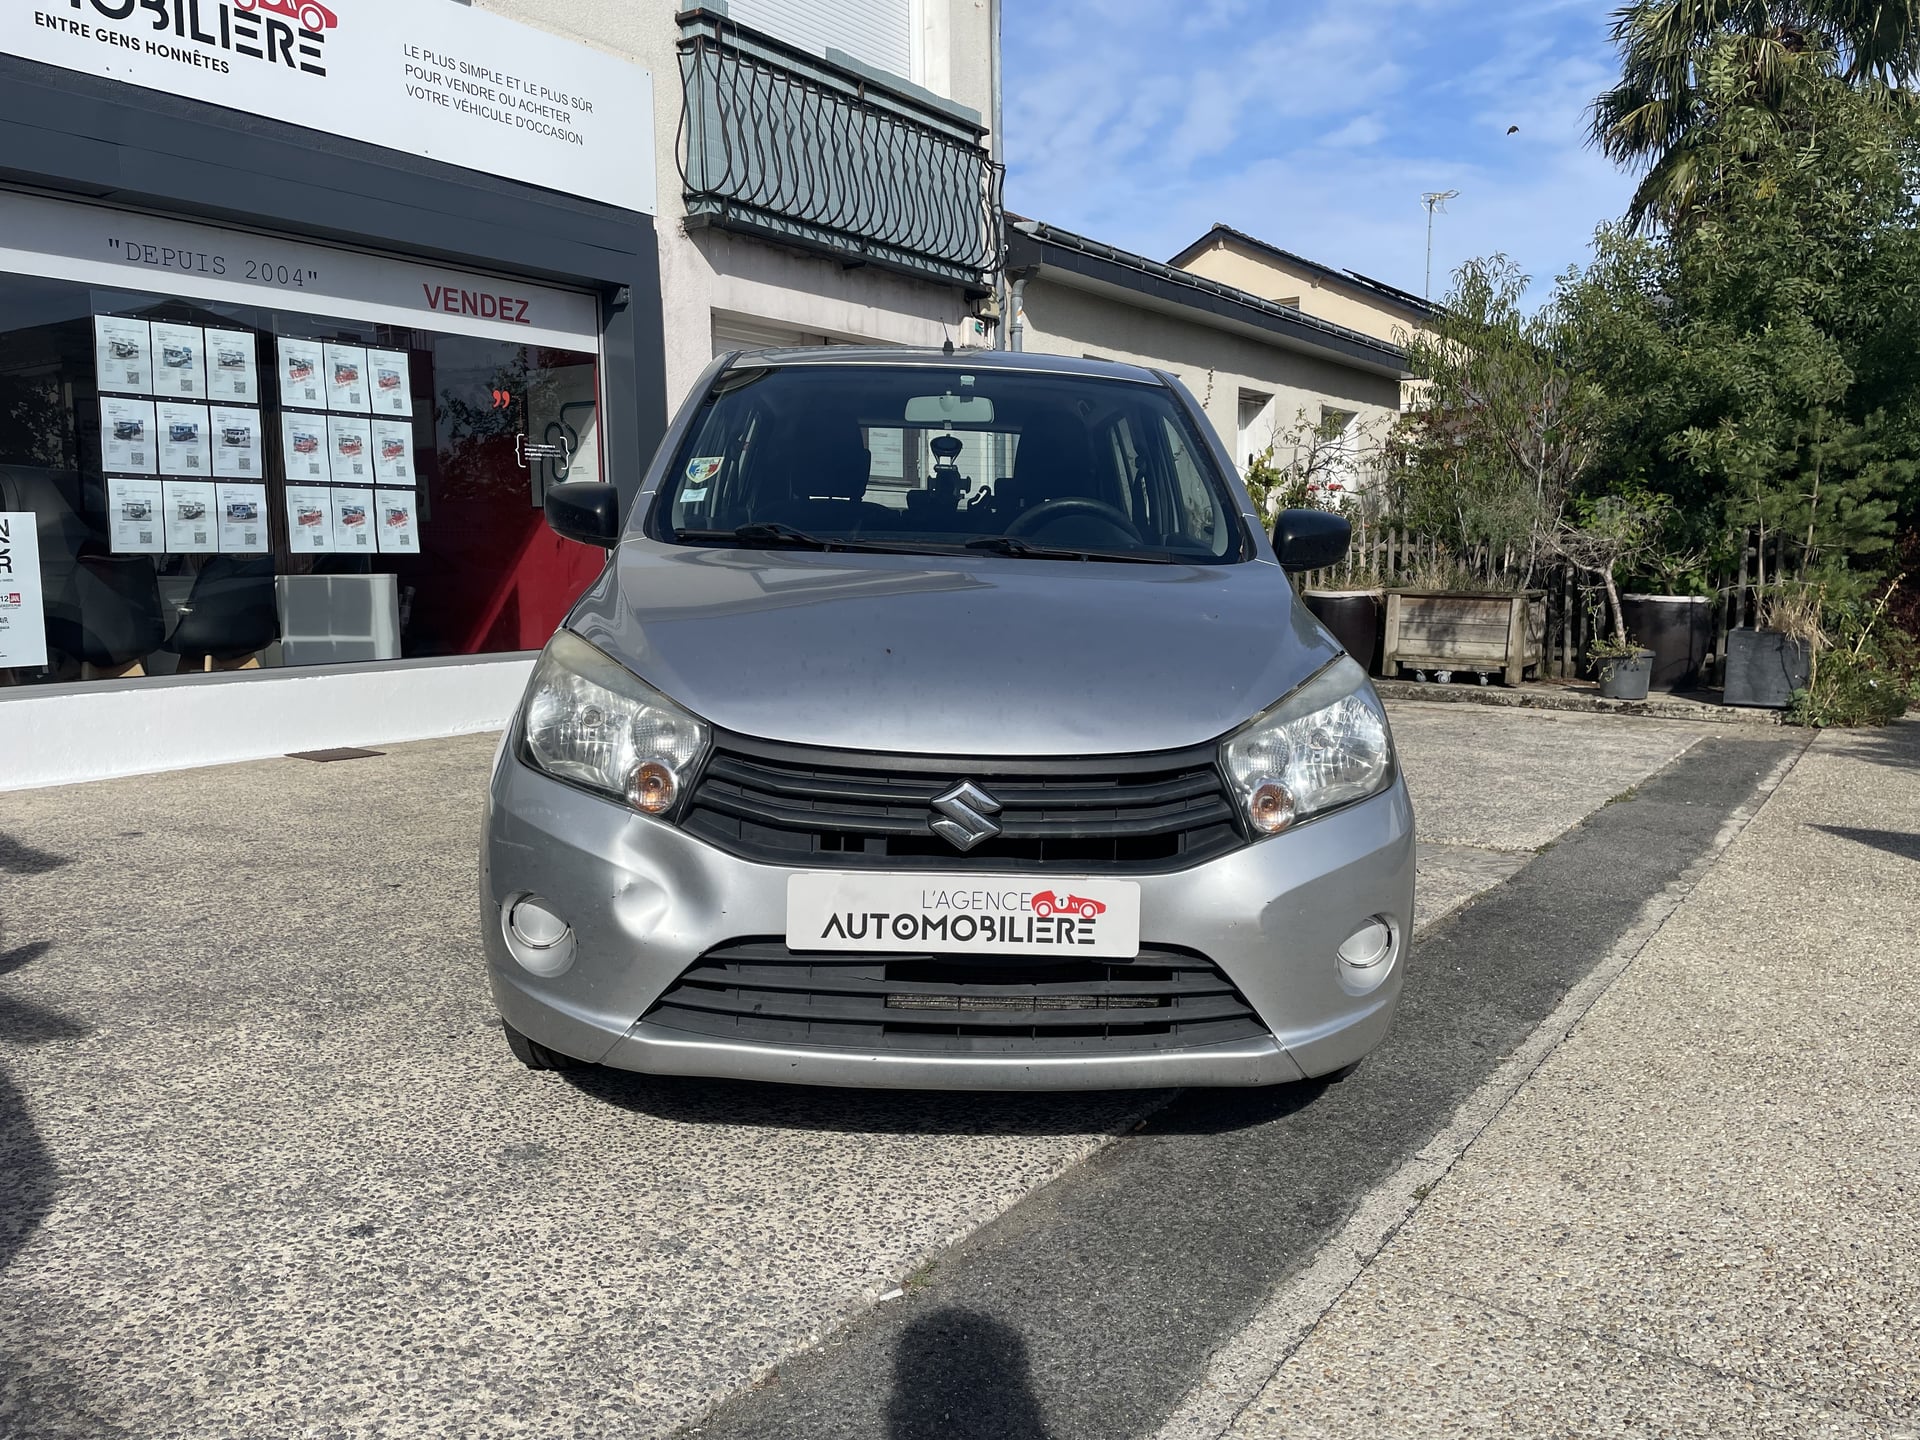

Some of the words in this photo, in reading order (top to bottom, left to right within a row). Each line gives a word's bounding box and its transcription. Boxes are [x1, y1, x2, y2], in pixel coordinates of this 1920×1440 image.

[34, 11, 91, 38] ENTRE
[95, 28, 141, 51] GENS
[145, 40, 230, 74] HONNÊTES
[70, 0, 327, 77] BILIERE
[403, 43, 420, 59] LE
[423, 49, 456, 70] PLUS
[459, 61, 503, 86] SIMPLE
[506, 75, 521, 91] ET
[523, 81, 538, 96] LE
[540, 86, 569, 106] PLUS
[571, 97, 594, 114] SÛR
[405, 63, 442, 86] POUR
[444, 75, 496, 102] VENDRE
[498, 92, 516, 108] OU
[518, 98, 571, 125] ACHETER
[405, 83, 450, 108] VOTRE
[452, 96, 513, 126] VÉHICULE
[515, 115, 584, 146] D'OCCASION
[108, 238, 227, 275] "DEPUIS
[245, 259, 319, 288] 2004"
[422, 283, 531, 324] VENDEZ
[820, 912, 1097, 945] AUTOMOBILIERE
[921, 889, 1032, 912] L'AGENCE
